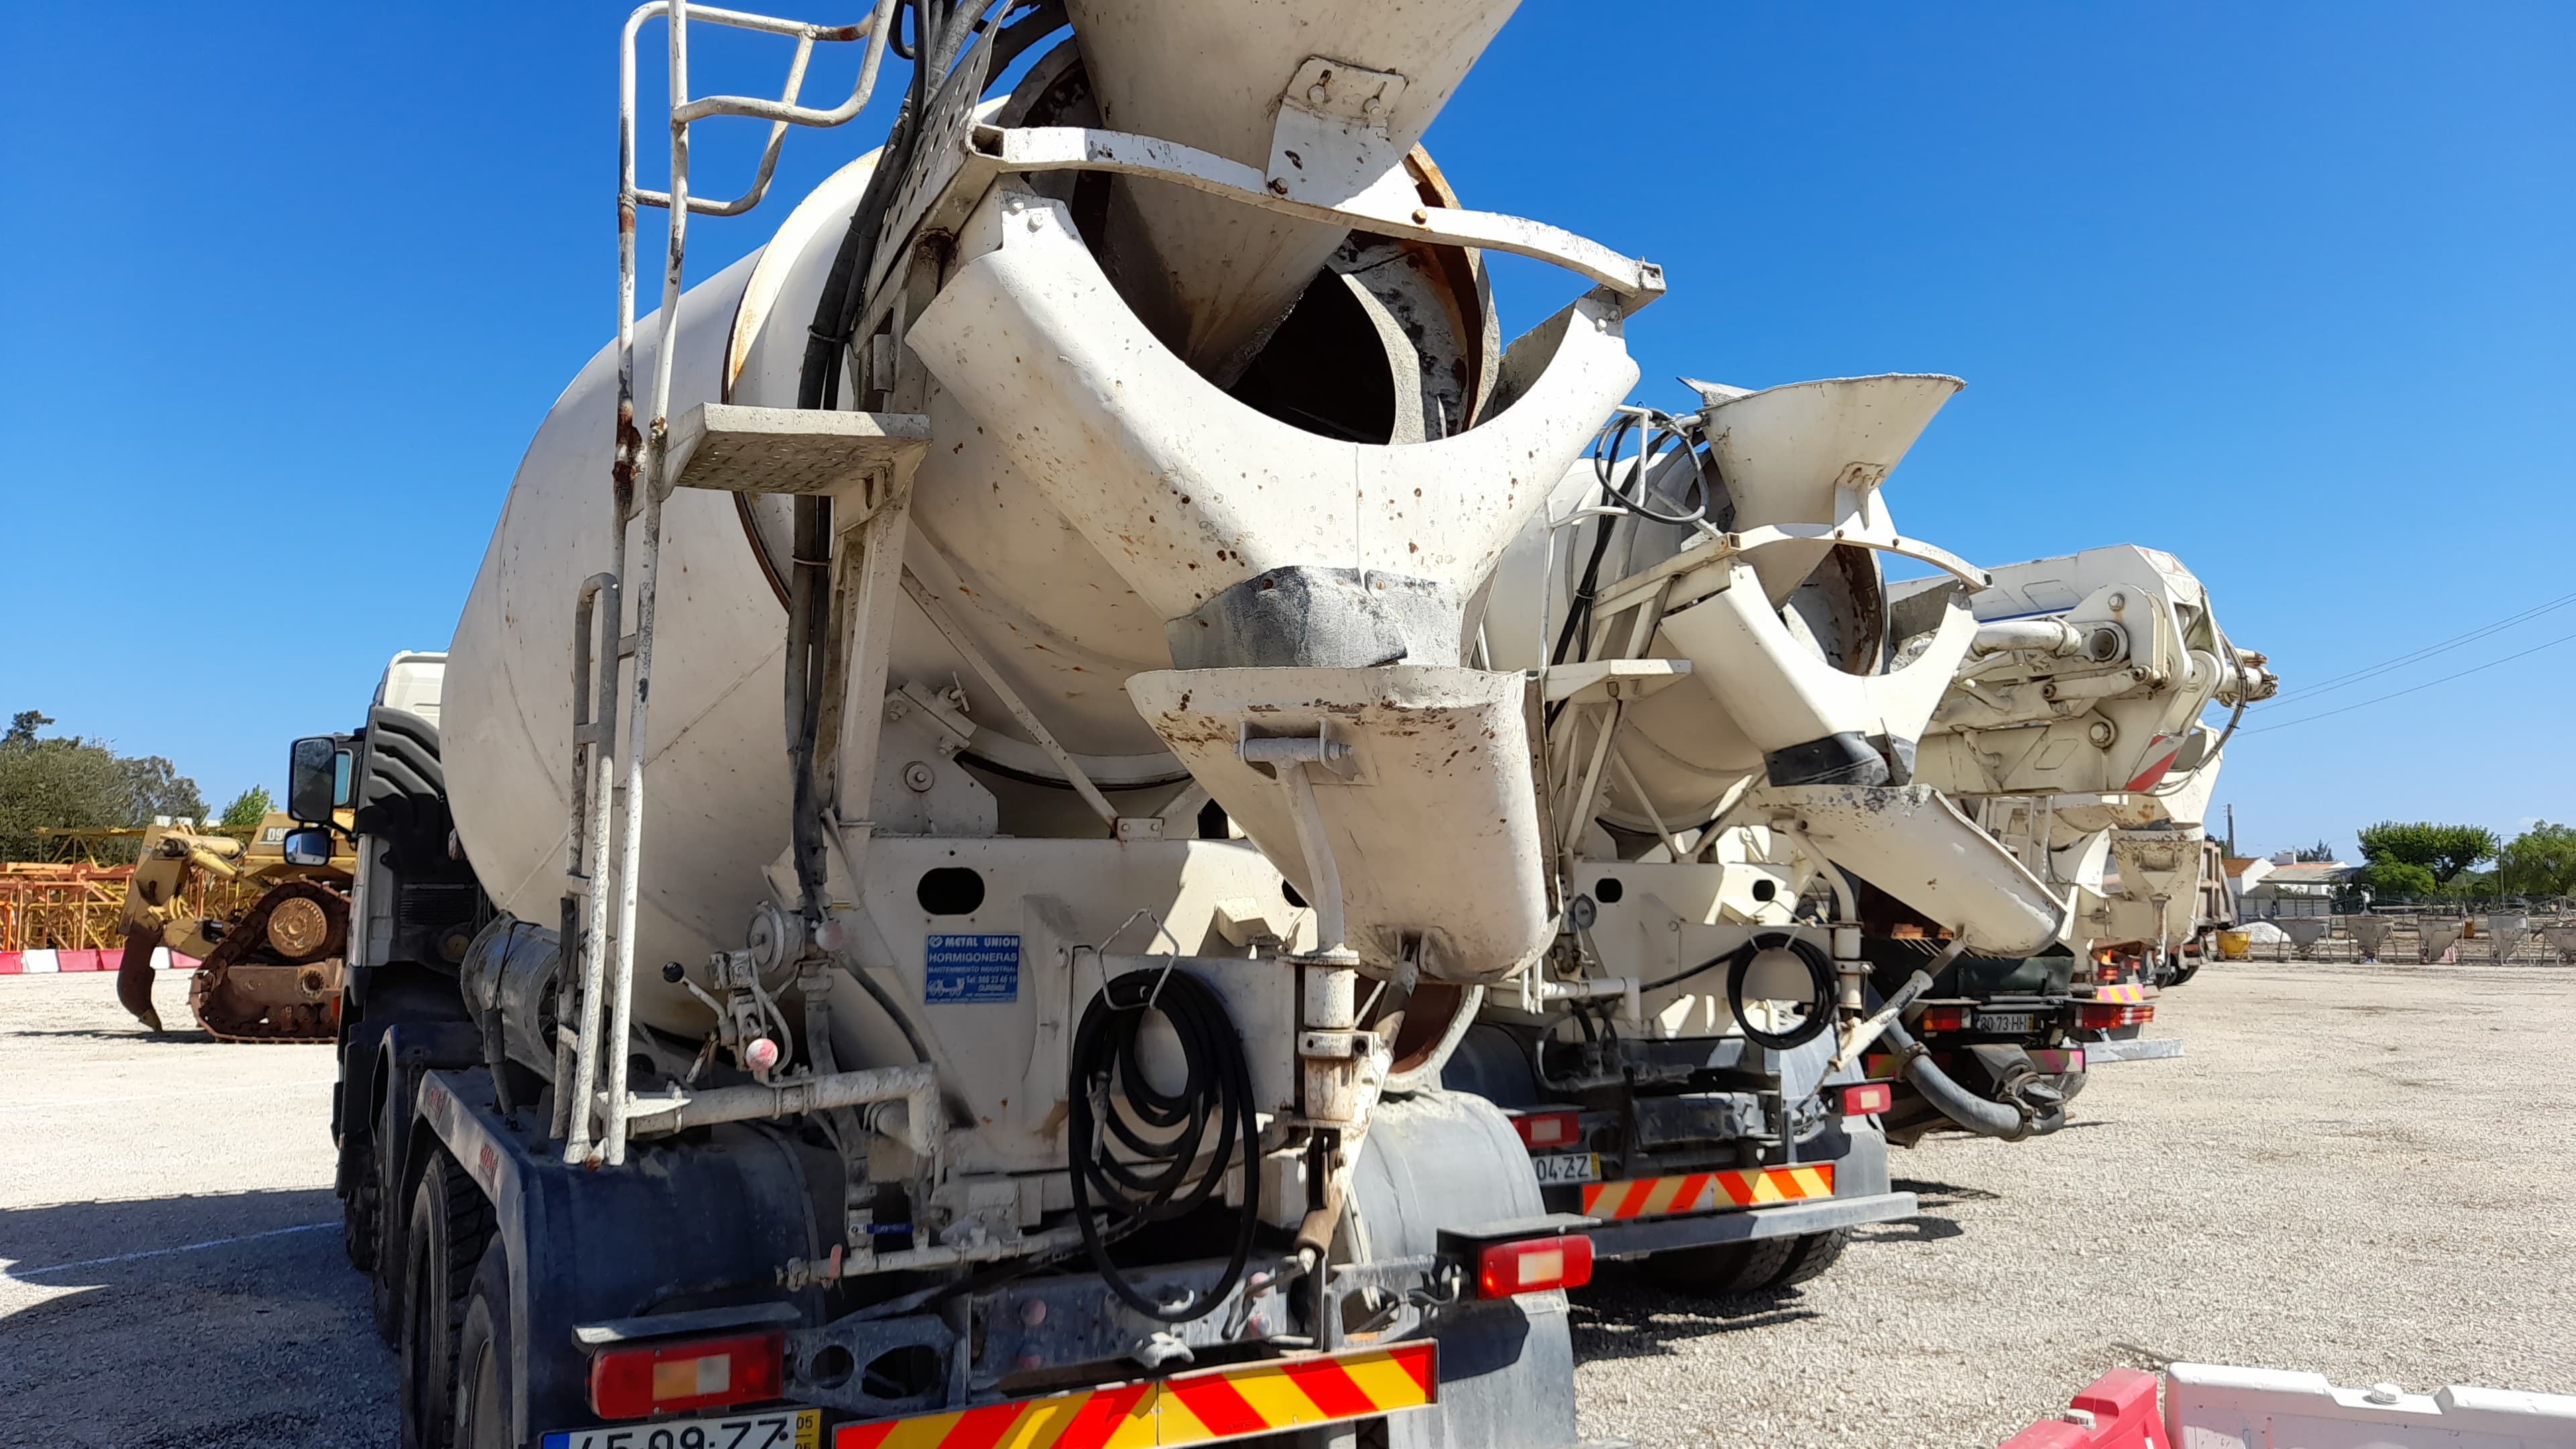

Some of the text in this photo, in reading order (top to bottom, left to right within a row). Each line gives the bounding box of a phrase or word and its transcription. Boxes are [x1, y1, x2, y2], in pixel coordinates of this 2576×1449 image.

[945, 937, 1018, 947] METAL UNION
[928, 953, 1018, 963] HORMIGONERAS
